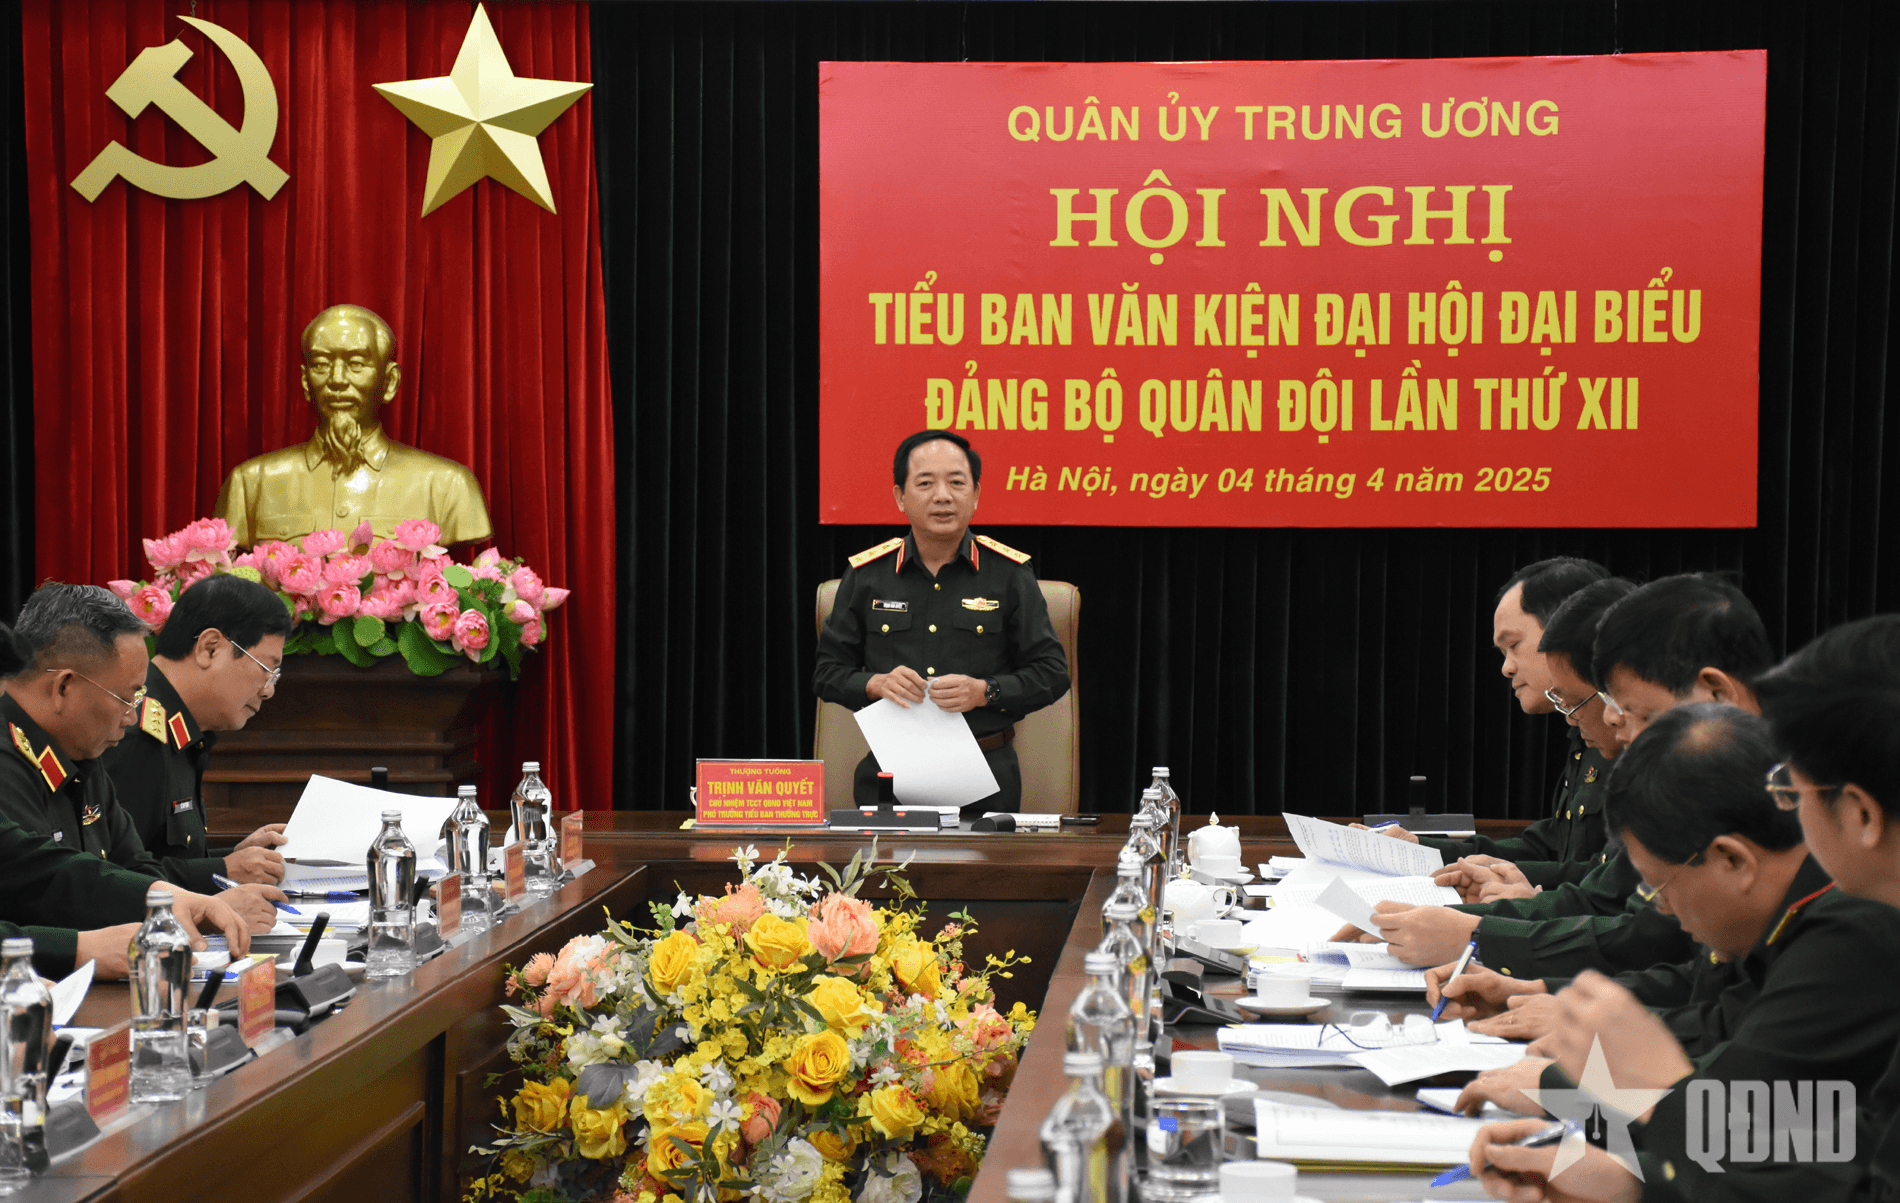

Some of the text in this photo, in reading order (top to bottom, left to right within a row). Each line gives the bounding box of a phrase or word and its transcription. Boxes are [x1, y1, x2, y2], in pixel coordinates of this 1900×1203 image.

[1008, 92, 1559, 142] QUÂN ỦY TRUNG ƯƠNG
[1049, 168, 1514, 265] HỘI NGHỊ
[869, 267, 1702, 358] TIỂU BAN VĂN KIỆN ĐẠI HỘI ĐẠI BIỂU
[924, 359, 1639, 444] ĐẢNG BỘ QUÂN ĐỘI LẦN THỨ XII
[1006, 466, 1552, 499] Hà Nội, ngày 04 tháng 4 năm 2025
[707, 777, 814, 797] TRỊNH VĂN QUYẾT
